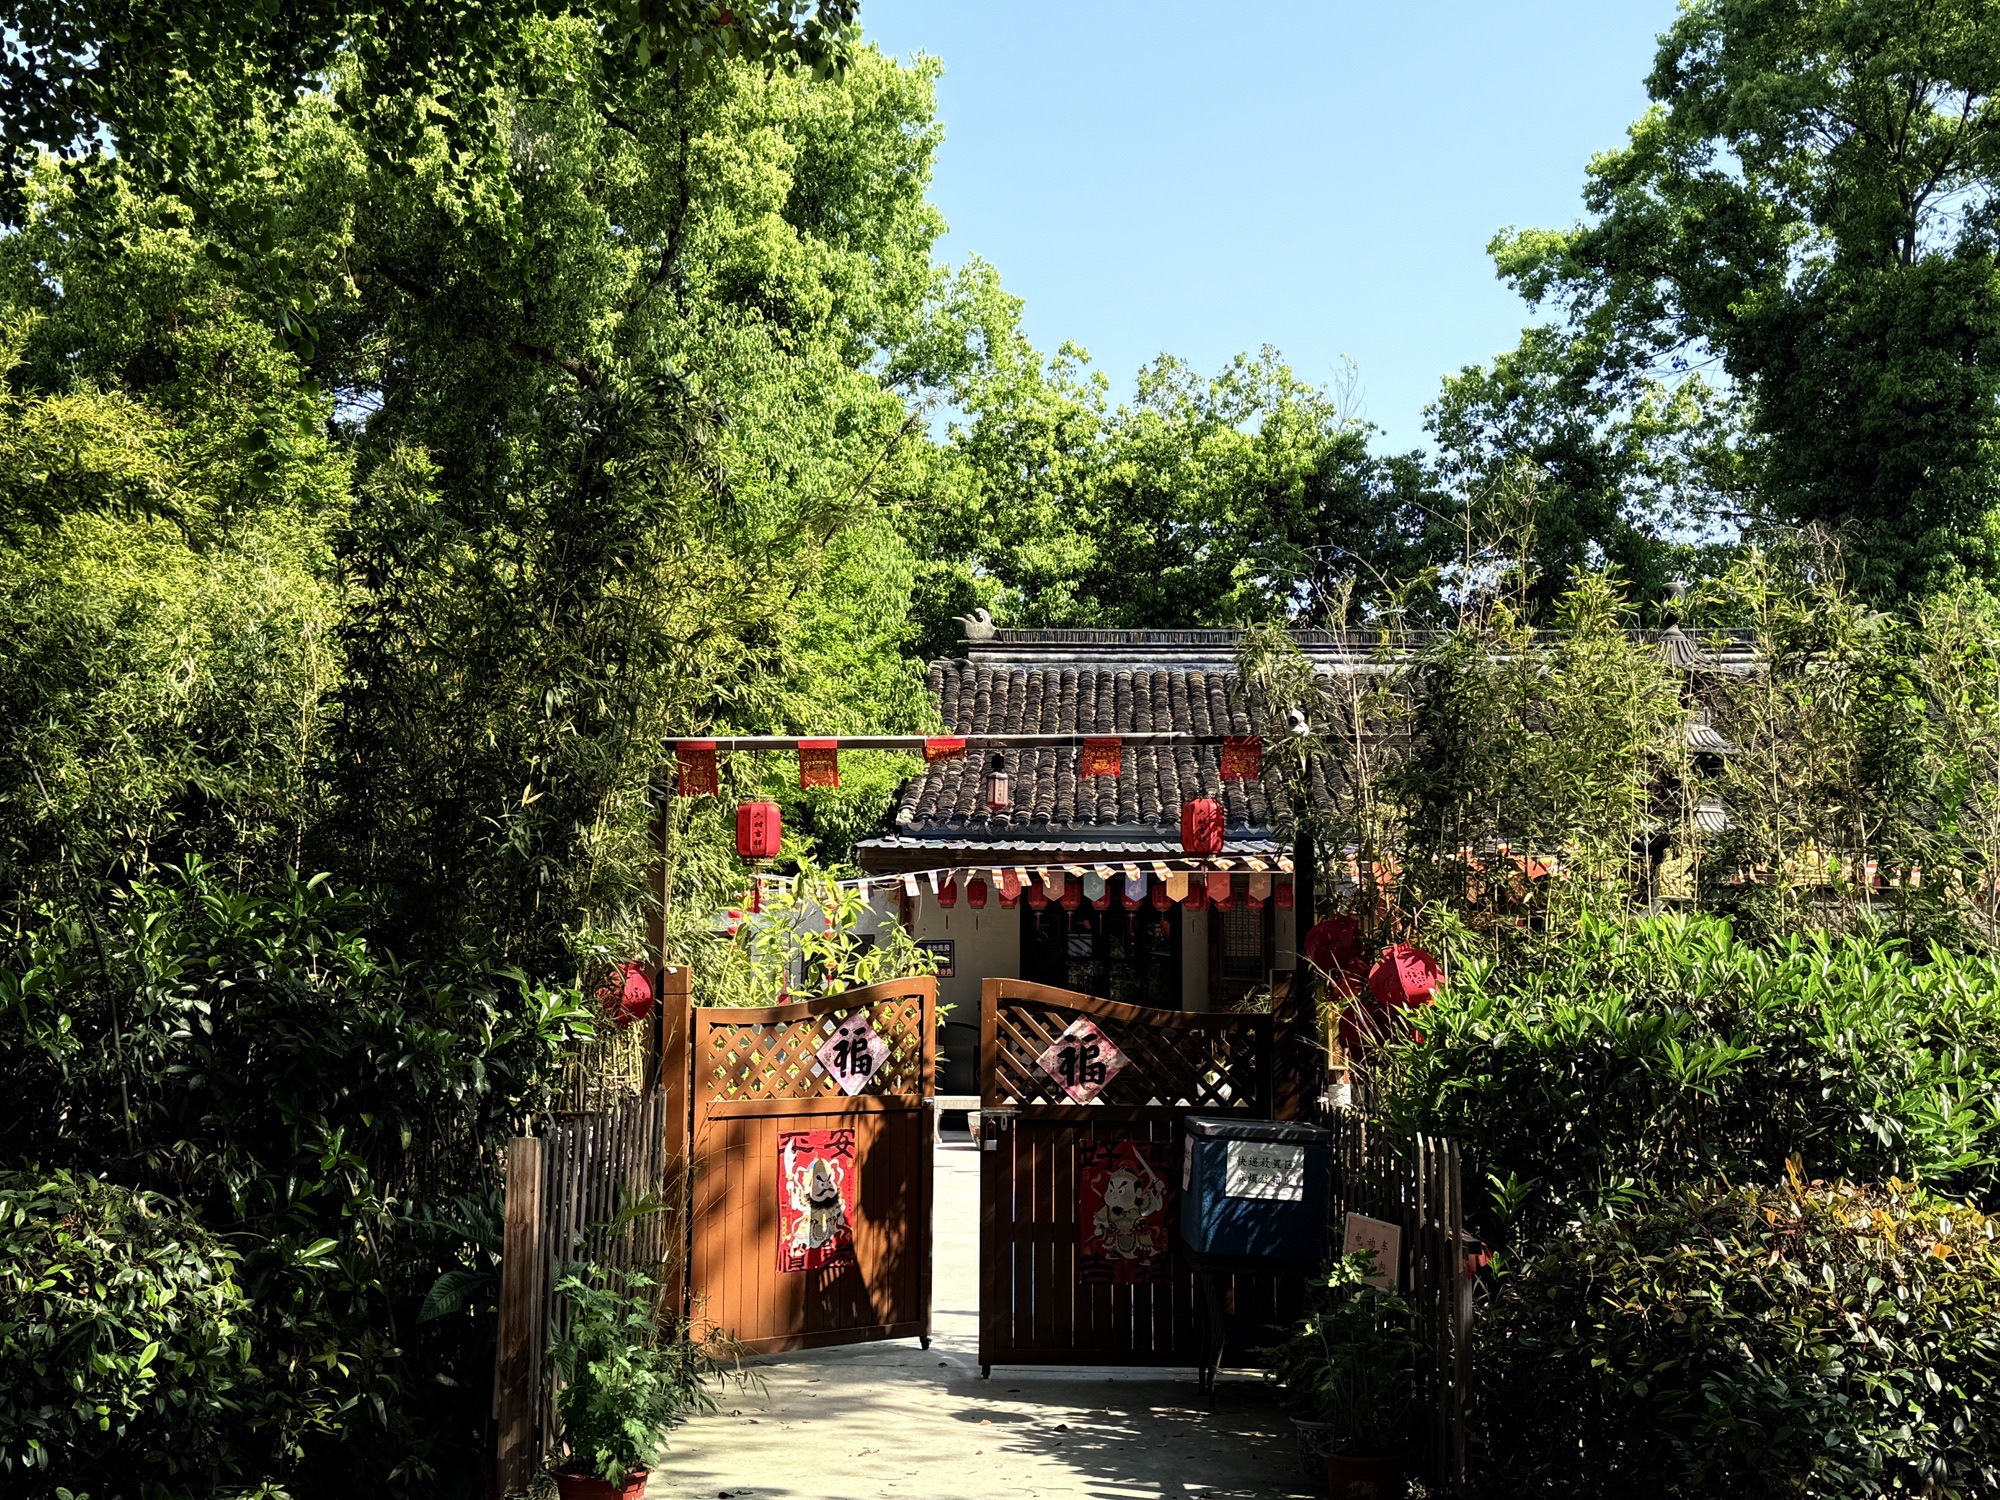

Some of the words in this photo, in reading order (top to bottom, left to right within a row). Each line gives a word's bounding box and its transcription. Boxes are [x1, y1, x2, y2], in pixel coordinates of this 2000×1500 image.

[832, 1026, 873, 1079] 福
[1056, 1033, 1107, 1087] 福
[1237, 1155, 1294, 1171] 快递放置区
